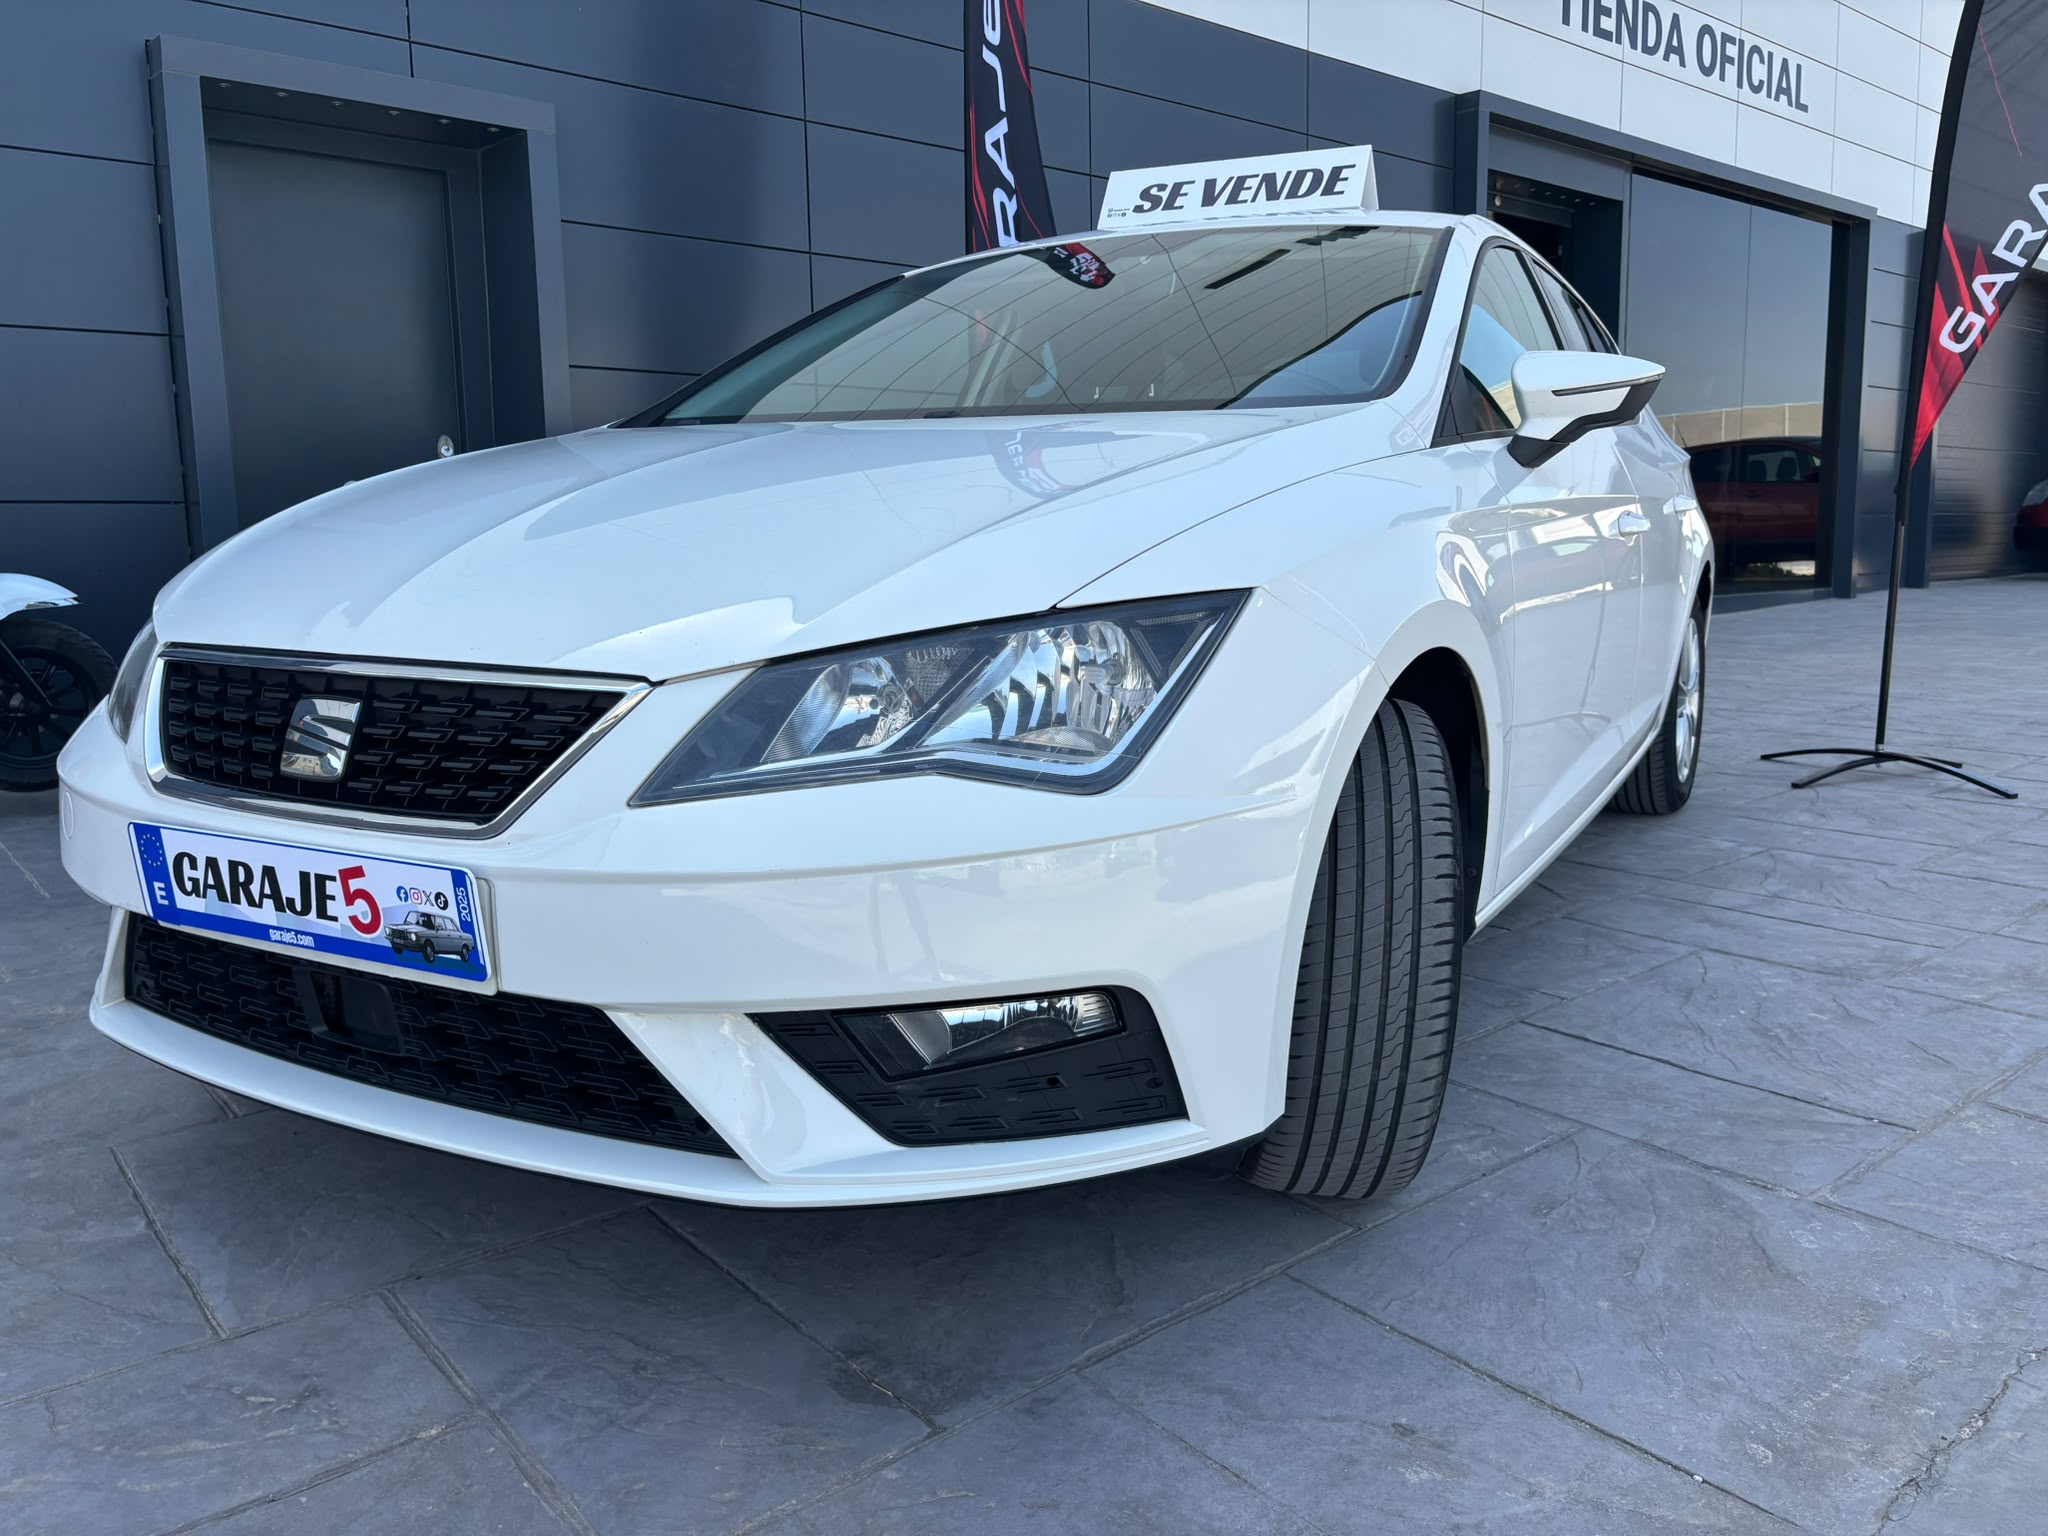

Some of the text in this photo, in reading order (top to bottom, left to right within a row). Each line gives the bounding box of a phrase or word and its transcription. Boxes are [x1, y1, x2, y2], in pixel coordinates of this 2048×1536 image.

[1696, 23, 1809, 113] OFICIAL
[1132, 163, 1357, 214] SE VENDE
[153, 881, 169, 906] E
[456, 887, 471, 922] 2025
[269, 928, 315, 948] garaje5.com
